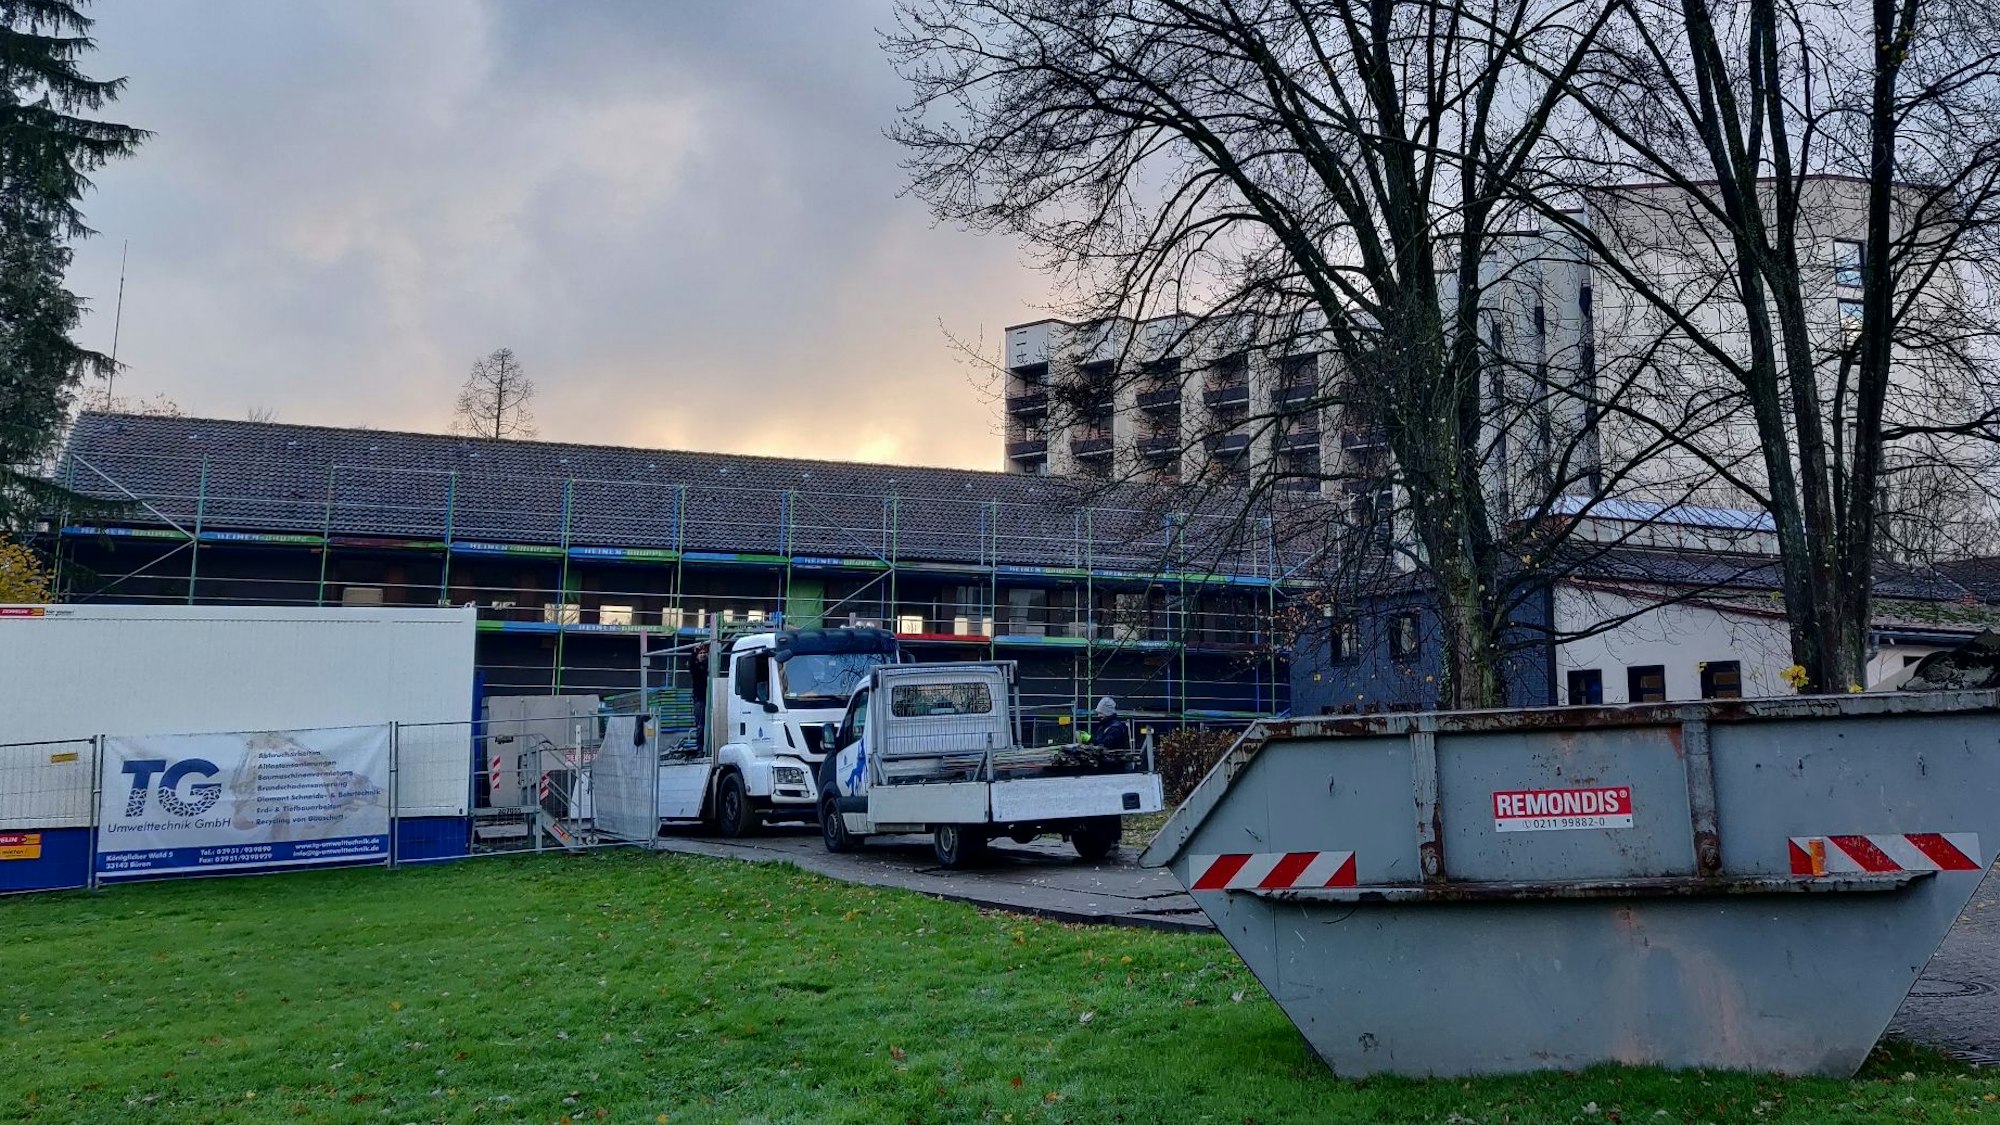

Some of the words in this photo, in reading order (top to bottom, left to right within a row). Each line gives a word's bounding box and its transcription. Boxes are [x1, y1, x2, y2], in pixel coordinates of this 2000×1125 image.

[80, 528, 175, 538] HEIEN-GRUPPE
[258, 750, 321, 759] Abbrucharbeiten
[258, 760, 337, 770] Altlastensanierungen
[258, 769, 354, 781] Baumaschinenvermietung
[121, 758, 222, 817] TG
[257, 781, 348, 792] Brandschadensanierung
[1496, 790, 1620, 817] REMONDIS
[107, 820, 191, 833] Umwelttechnik
[198, 817, 231, 830] GmbH
[255, 816, 290, 826] Recycling
[1533, 819, 1557, 829] 0211
[1562, 817, 1605, 827] 99882-0
[294, 837, 380, 850] www.tg-umwelttechnik.de
[149, 851, 167, 859] Wald
[293, 844, 380, 857] info@tg-umwelttechnik.de
